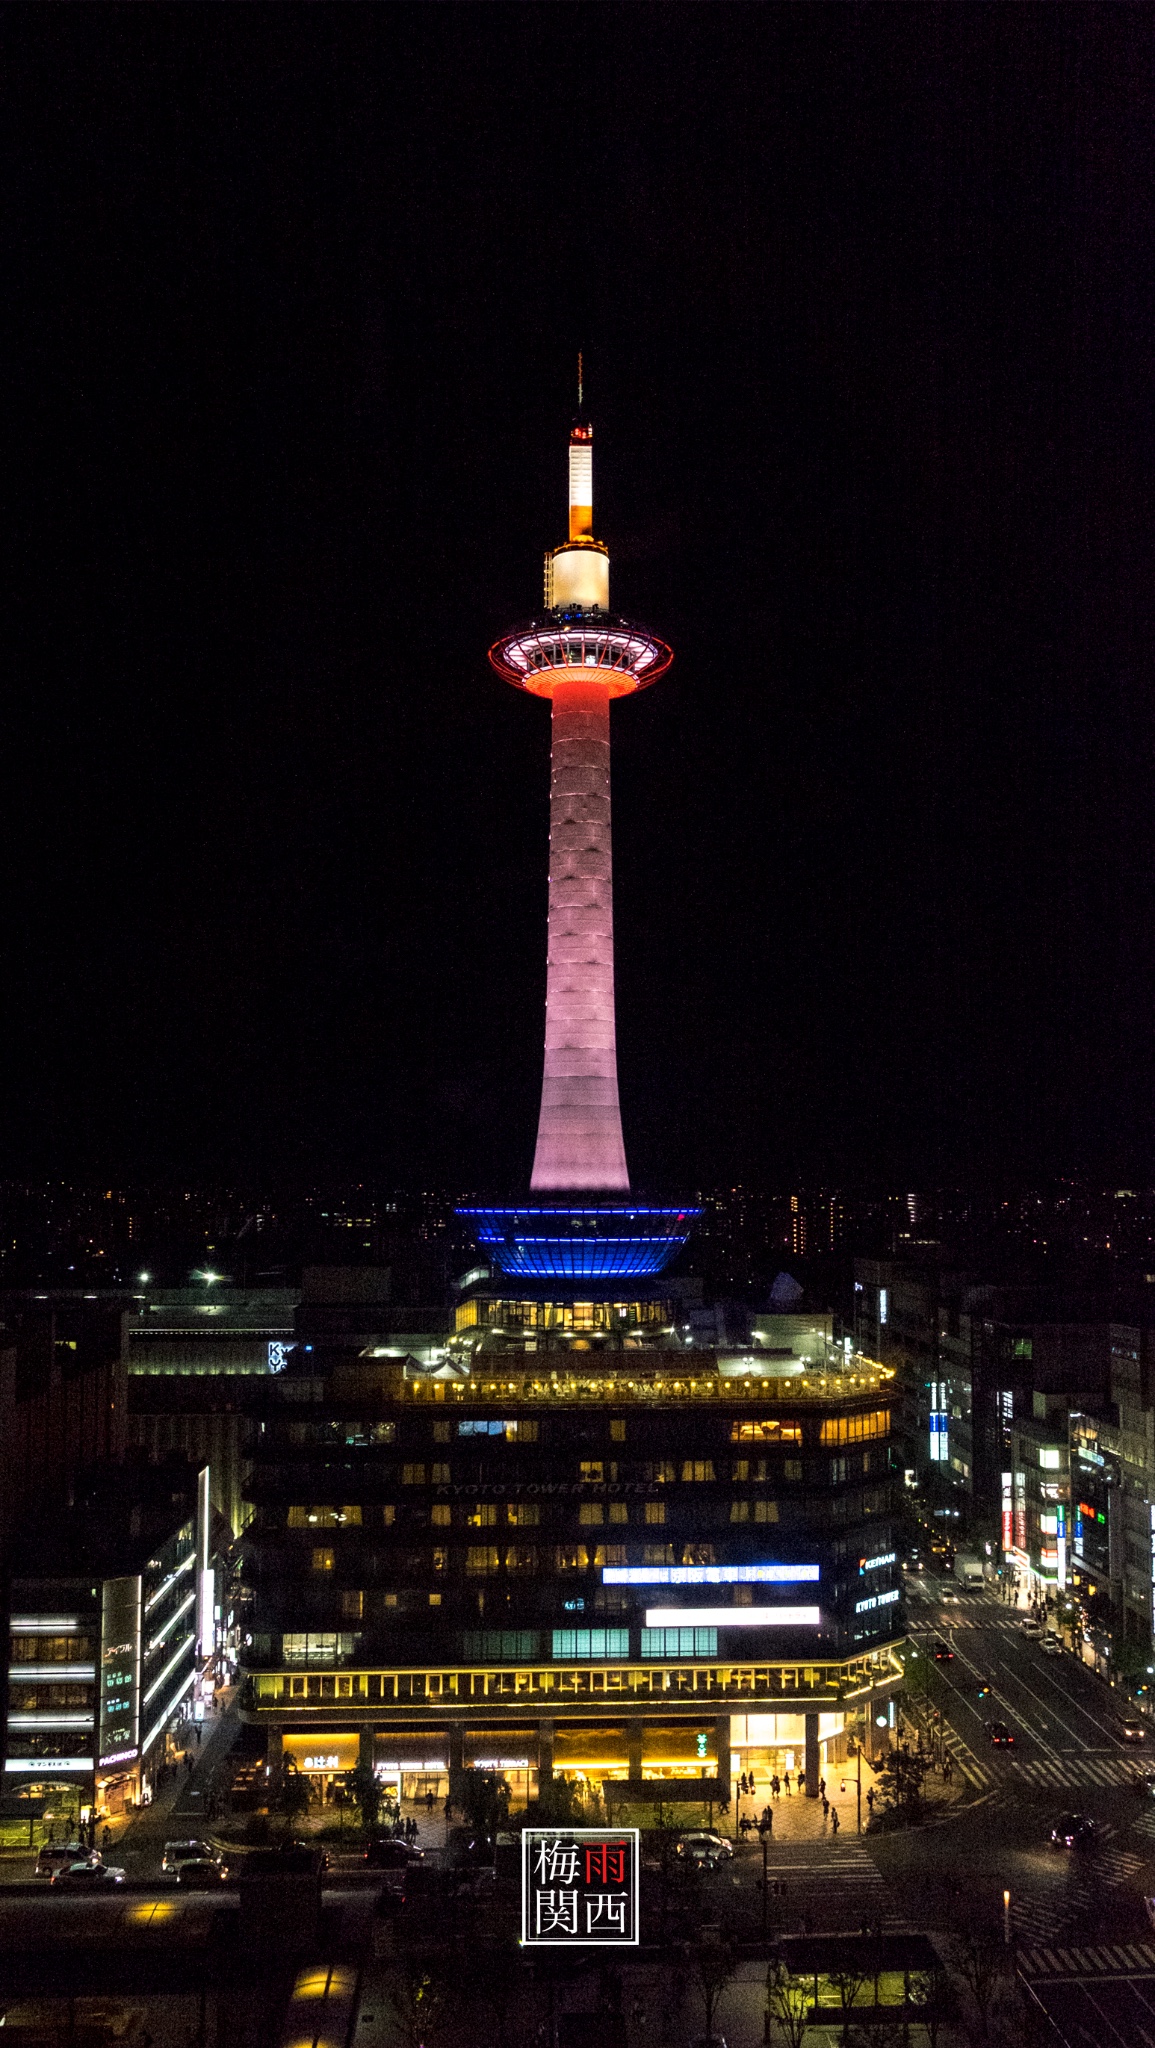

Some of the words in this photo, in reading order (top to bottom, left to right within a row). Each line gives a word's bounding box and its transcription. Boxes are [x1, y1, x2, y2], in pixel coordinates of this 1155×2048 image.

[436, 1483, 507, 1496] KYOTO
[513, 1483, 584, 1496] TOWER
[592, 1482, 660, 1494] HOTEL
[865, 1552, 896, 1570] KEIHAN
[855, 1597, 877, 1614] KYOTO
[877, 1590, 899, 1606] TOWER
[99, 1748, 138, 1767] PACHINCO
